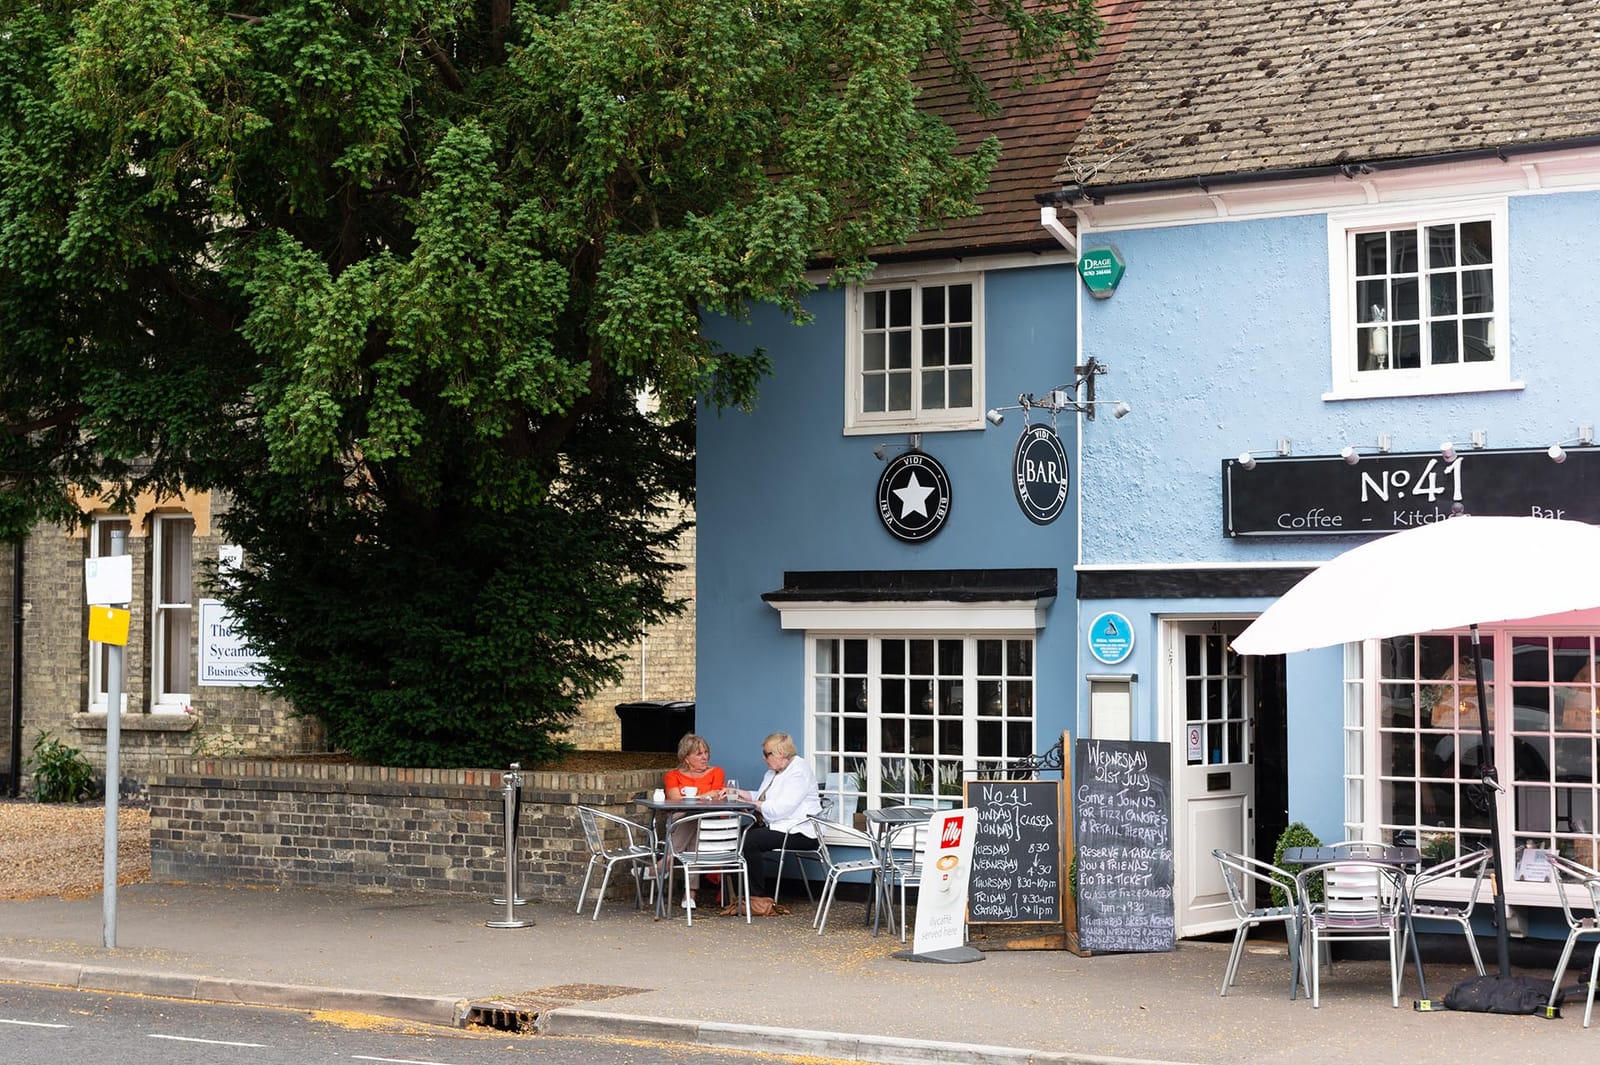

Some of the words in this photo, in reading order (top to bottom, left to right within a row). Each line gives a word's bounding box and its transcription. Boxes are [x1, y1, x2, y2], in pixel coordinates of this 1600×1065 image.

[1035, 430, 1049, 440] VIDI
[903, 456, 923, 465] VIDI
[1026, 459, 1060, 484] BAR
[881, 499, 894, 524] VENI
[1277, 507, 1343, 529] Coffee
[1393, 506, 1471, 526] Kitch
[1531, 505, 1565, 521] Bar
[211, 624, 232, 637] The
[210, 644, 260, 660] Sycamo
[208, 665, 249, 677] Business
[1088, 741, 1148, 771] WEDNESDAY
[1121, 768, 1150, 792] JULY
[1117, 788, 1140, 808] JOIN
[1141, 796, 1156, 808] US
[1078, 803, 1096, 818] FOR
[1020, 814, 1053, 833] CLOSED
[943, 821, 961, 845] illy
[1089, 819, 1122, 835] RETAIL
[1121, 823, 1168, 845] THERAPY!
[1080, 845, 1119, 858] RESERVE
[1122, 847, 1128, 858] A
[1128, 846, 1157, 860] TABLE
[1079, 860, 1097, 872] YOU
[973, 875, 1012, 891] THURSDAY
[1080, 872, 1094, 885] £10
[1095, 873, 1114, 885] PER
[1114, 872, 1152, 886] TICKET
[974, 890, 1006, 905] FRIDAY
[973, 904, 1013, 920] SATURDAY
